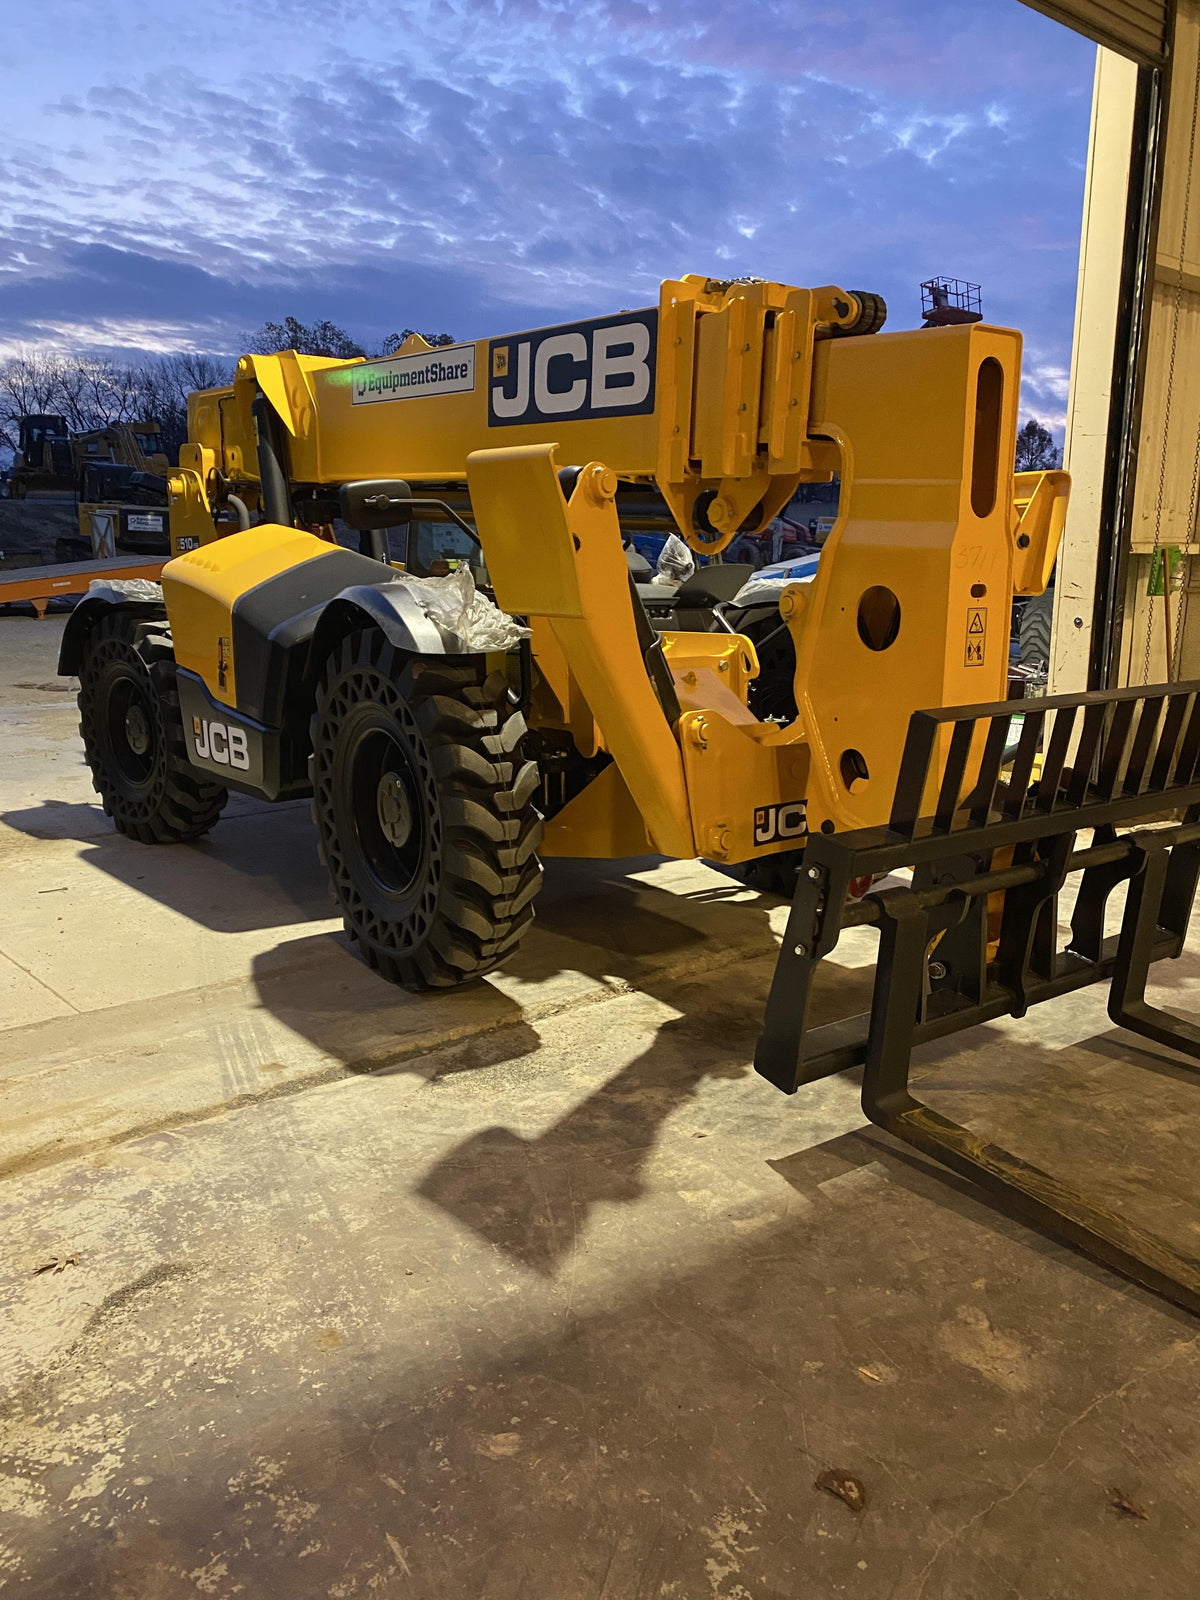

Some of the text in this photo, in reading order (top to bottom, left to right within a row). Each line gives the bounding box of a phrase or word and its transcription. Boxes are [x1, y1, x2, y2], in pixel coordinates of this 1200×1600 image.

[368, 362, 468, 395] EquipmentShare
[492, 322, 650, 418] JCB
[195, 719, 250, 770] JCB
